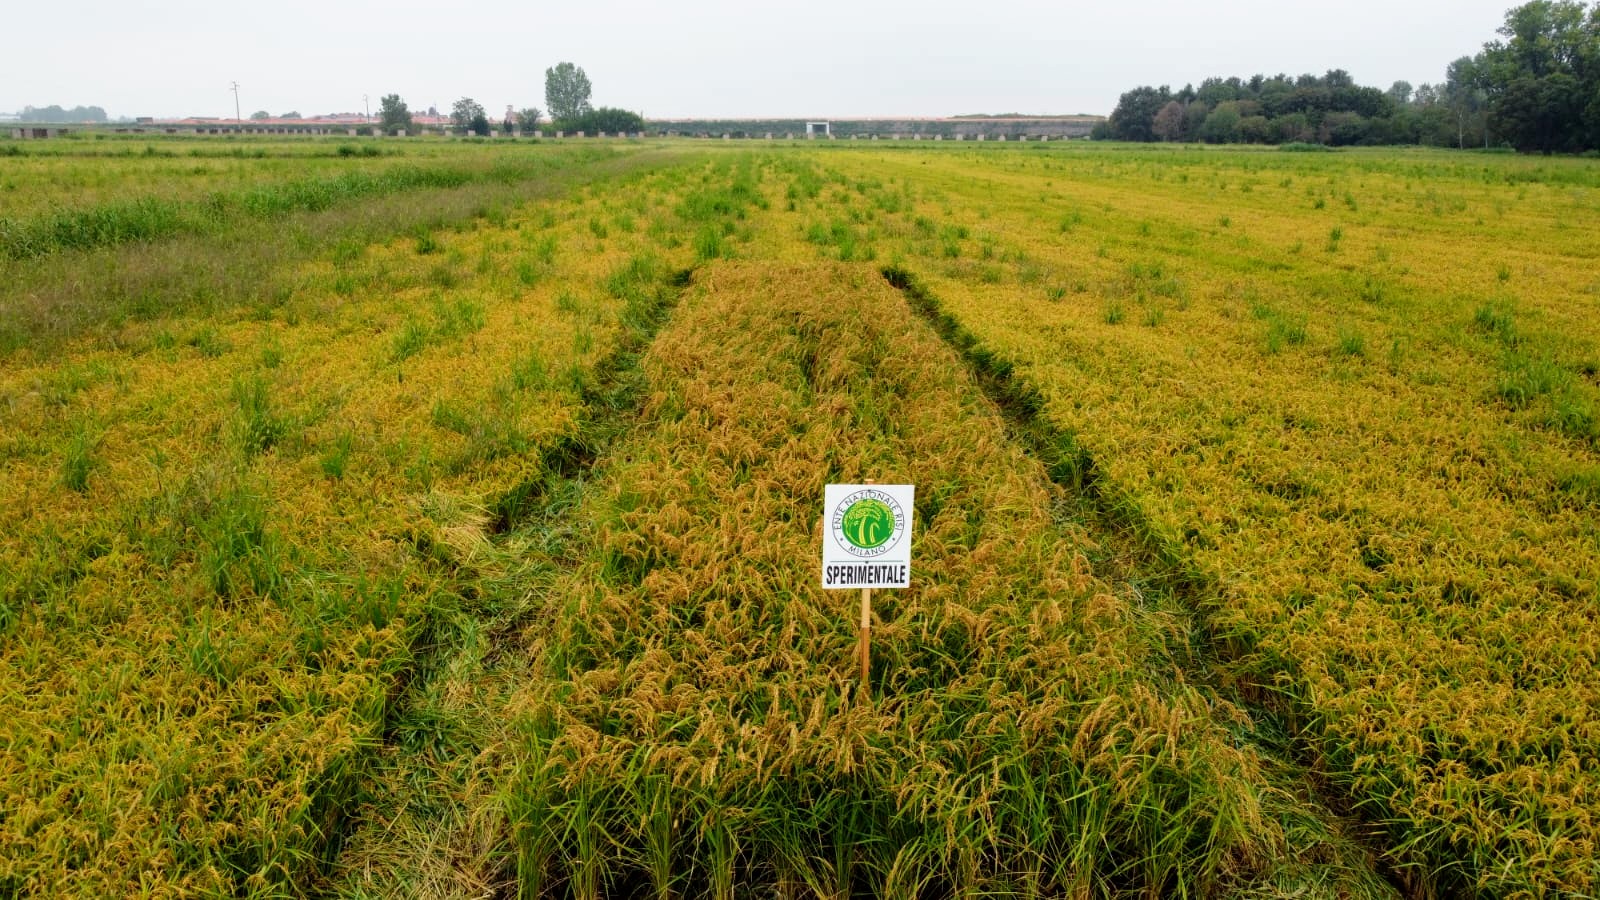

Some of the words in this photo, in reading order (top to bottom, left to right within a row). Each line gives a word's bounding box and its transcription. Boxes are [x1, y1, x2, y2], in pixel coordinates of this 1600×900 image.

[833, 507, 845, 530] ENTE
[845, 492, 898, 511] NAZIONALE
[895, 513, 903, 531] RISI
[848, 545, 886, 556] MILANO
[826, 565, 906, 585] SPERIMENTALE
